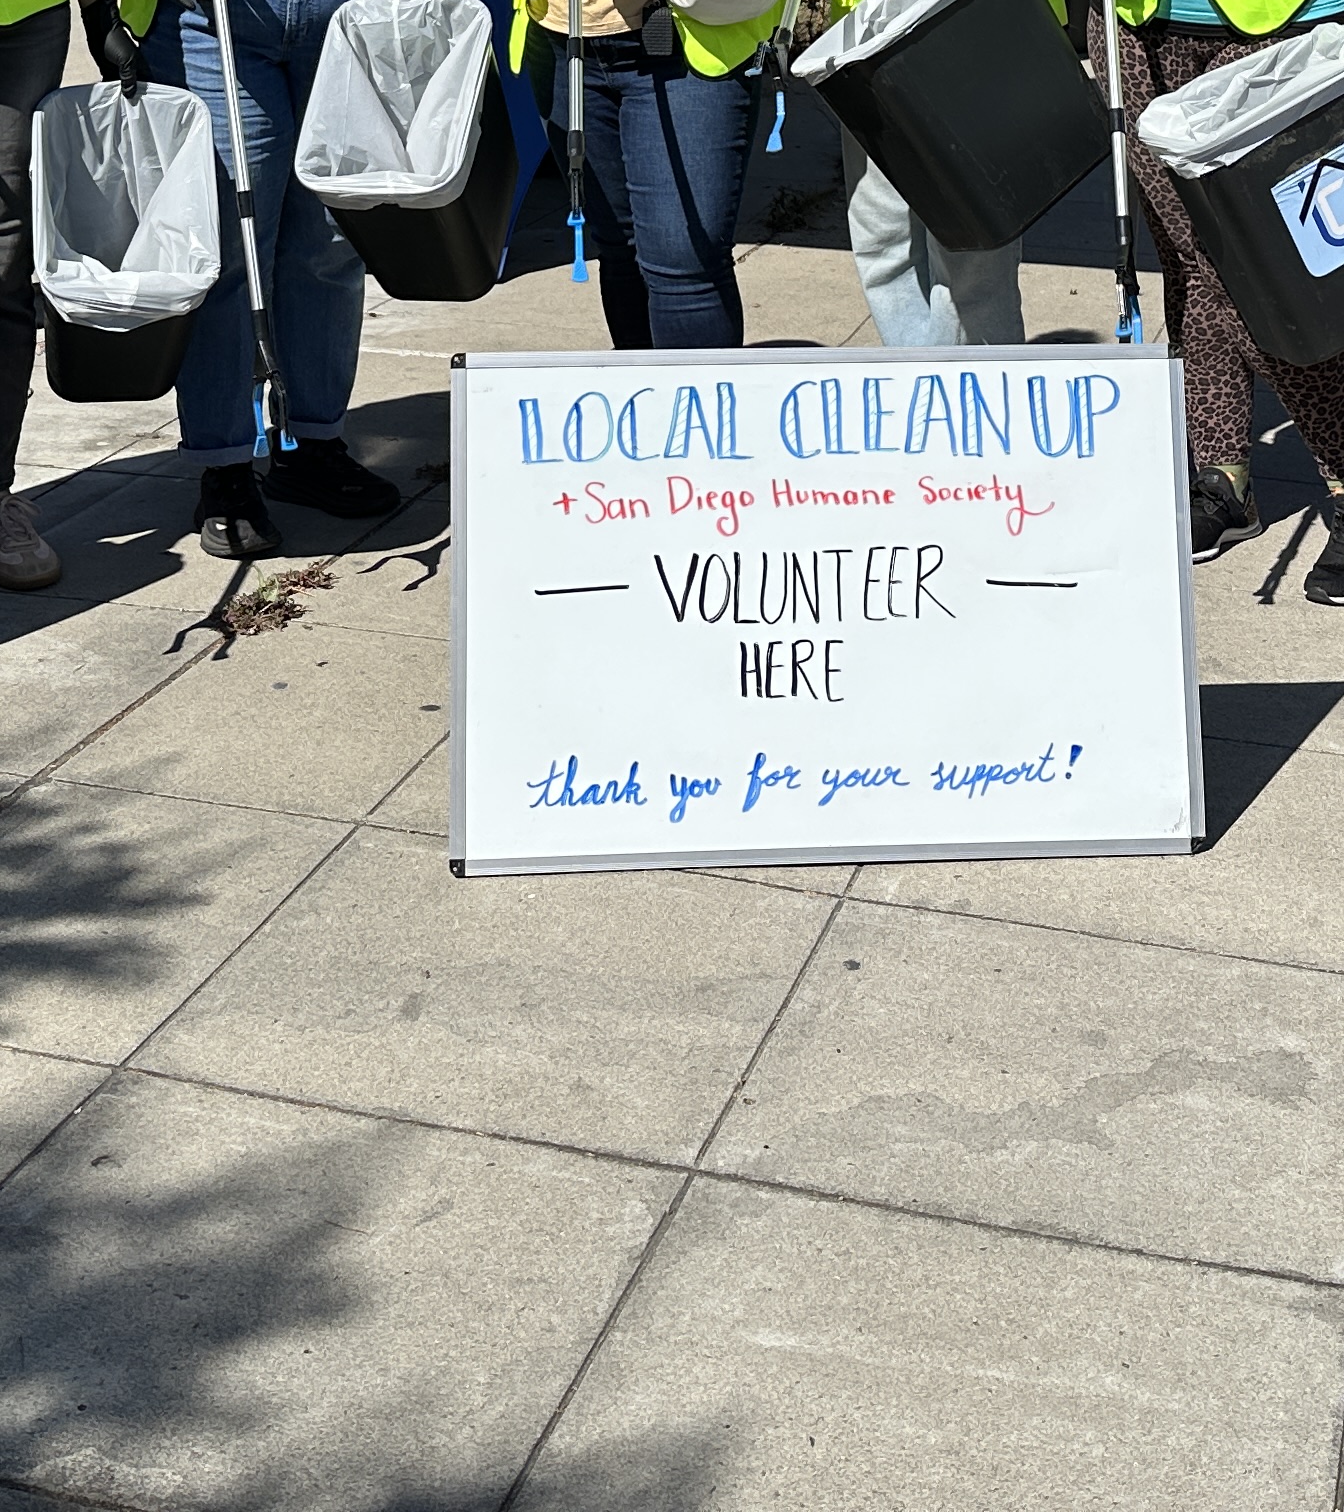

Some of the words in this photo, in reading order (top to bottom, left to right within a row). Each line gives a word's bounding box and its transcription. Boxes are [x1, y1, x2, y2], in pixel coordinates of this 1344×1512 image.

[518, 380, 757, 465] LOCAL
[666, 475, 755, 538] Diego
[772, 478, 896, 508] Humane
[918, 473, 1057, 538] Society
[653, 544, 957, 625] VOLUNTEER
[739, 638, 846, 703] HERE
[527, 754, 649, 809] thank
[669, 772, 721, 823] you
[741, 751, 805, 813] for
[818, 765, 912, 808] your
[931, 741, 1084, 801] support!
